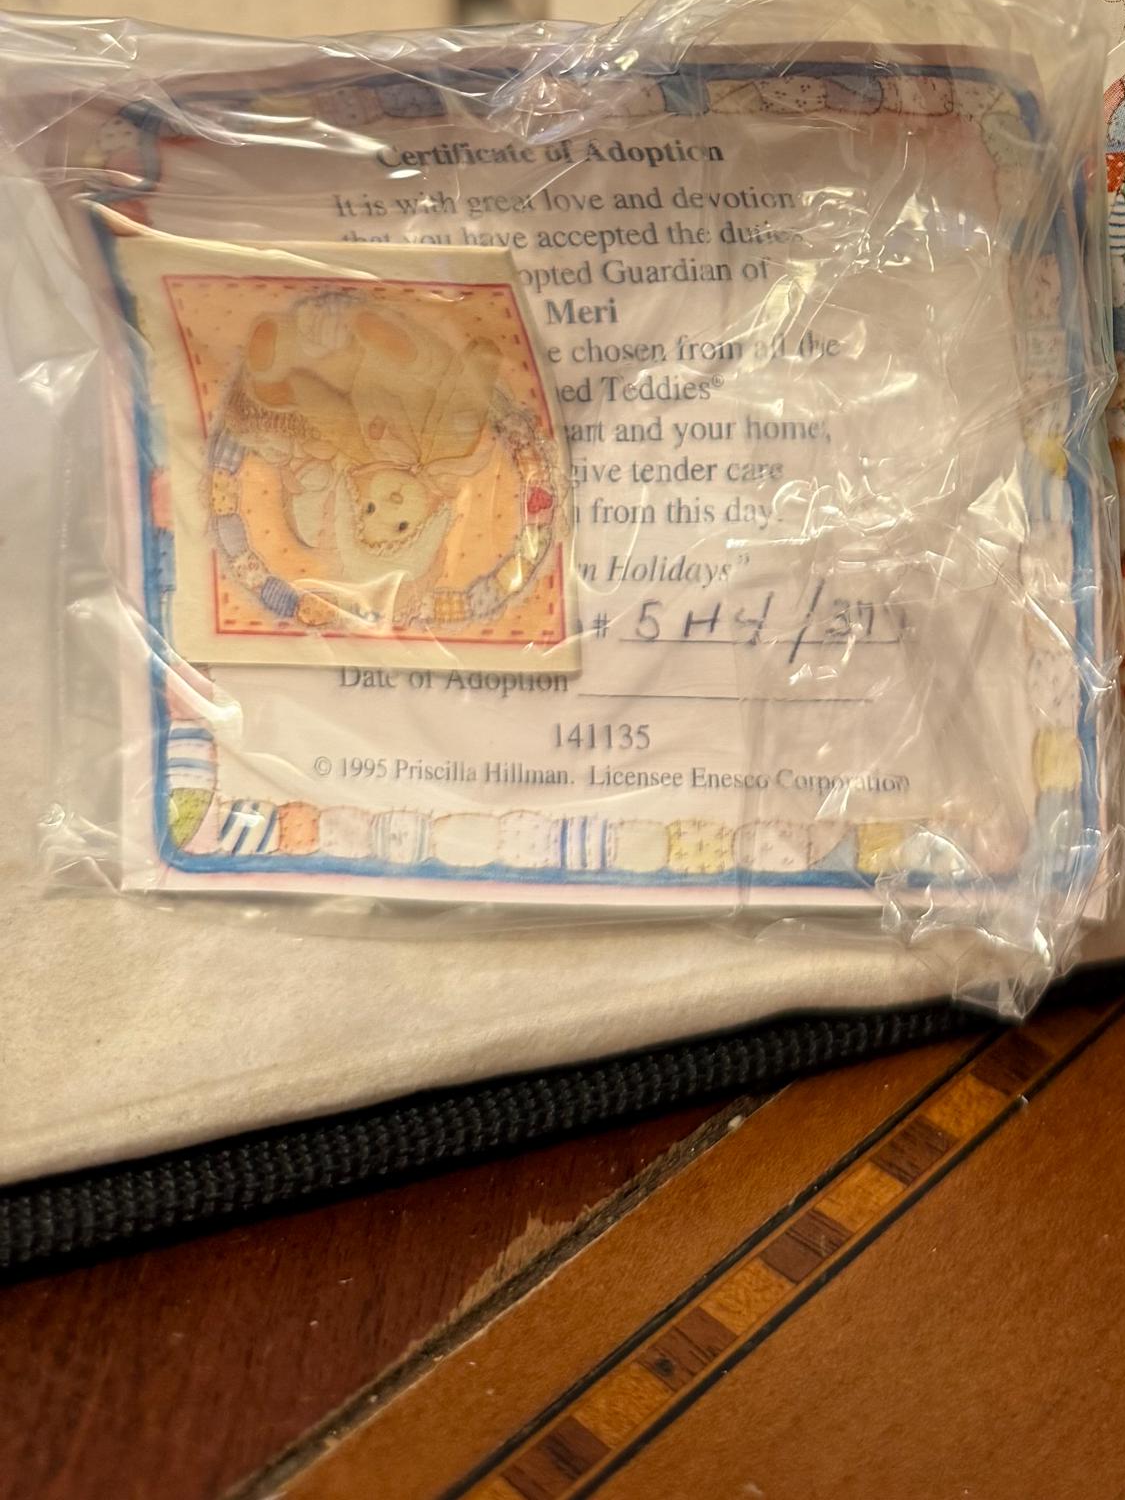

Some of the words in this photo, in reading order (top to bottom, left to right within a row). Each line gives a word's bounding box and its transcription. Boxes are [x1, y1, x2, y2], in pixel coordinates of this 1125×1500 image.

[376, 141, 535, 168] Certificate
[544, 140, 572, 164] of
[585, 138, 724, 168] Adoption
[335, 194, 357, 217] It
[361, 193, 387, 216] is
[397, 191, 457, 216] with
[468, 193, 535, 220] great
[545, 188, 604, 214] love
[614, 187, 663, 209] and
[672, 186, 796, 211] devotion
[460, 227, 527, 249] have
[537, 222, 658, 254] accepted
[666, 222, 710, 246] the
[602, 258, 731, 285] Guardian
[742, 256, 769, 280] of
[546, 298, 618, 324] Meri
[571, 340, 667, 364] chosen
[676, 334, 742, 360] from
[615, 416, 662, 442] and
[672, 421, 737, 448] your
[570, 459, 623, 489] give
[630, 459, 718, 482] tender
[726, 462, 785, 482] care
[592, 499, 655, 523] from
[666, 497, 715, 523] this
[340, 665, 397, 688] Date
[408, 670, 433, 689] of
[446, 669, 569, 698] Adoption
[553, 722, 651, 750] 141135
[340, 756, 387, 778] 1995
[395, 759, 478, 782] Priscilla
[484, 762, 575, 786] Hillman.
[588, 765, 683, 787] Licensee
[690, 766, 770, 790] Enesco
[776, 768, 911, 795] Corporation
